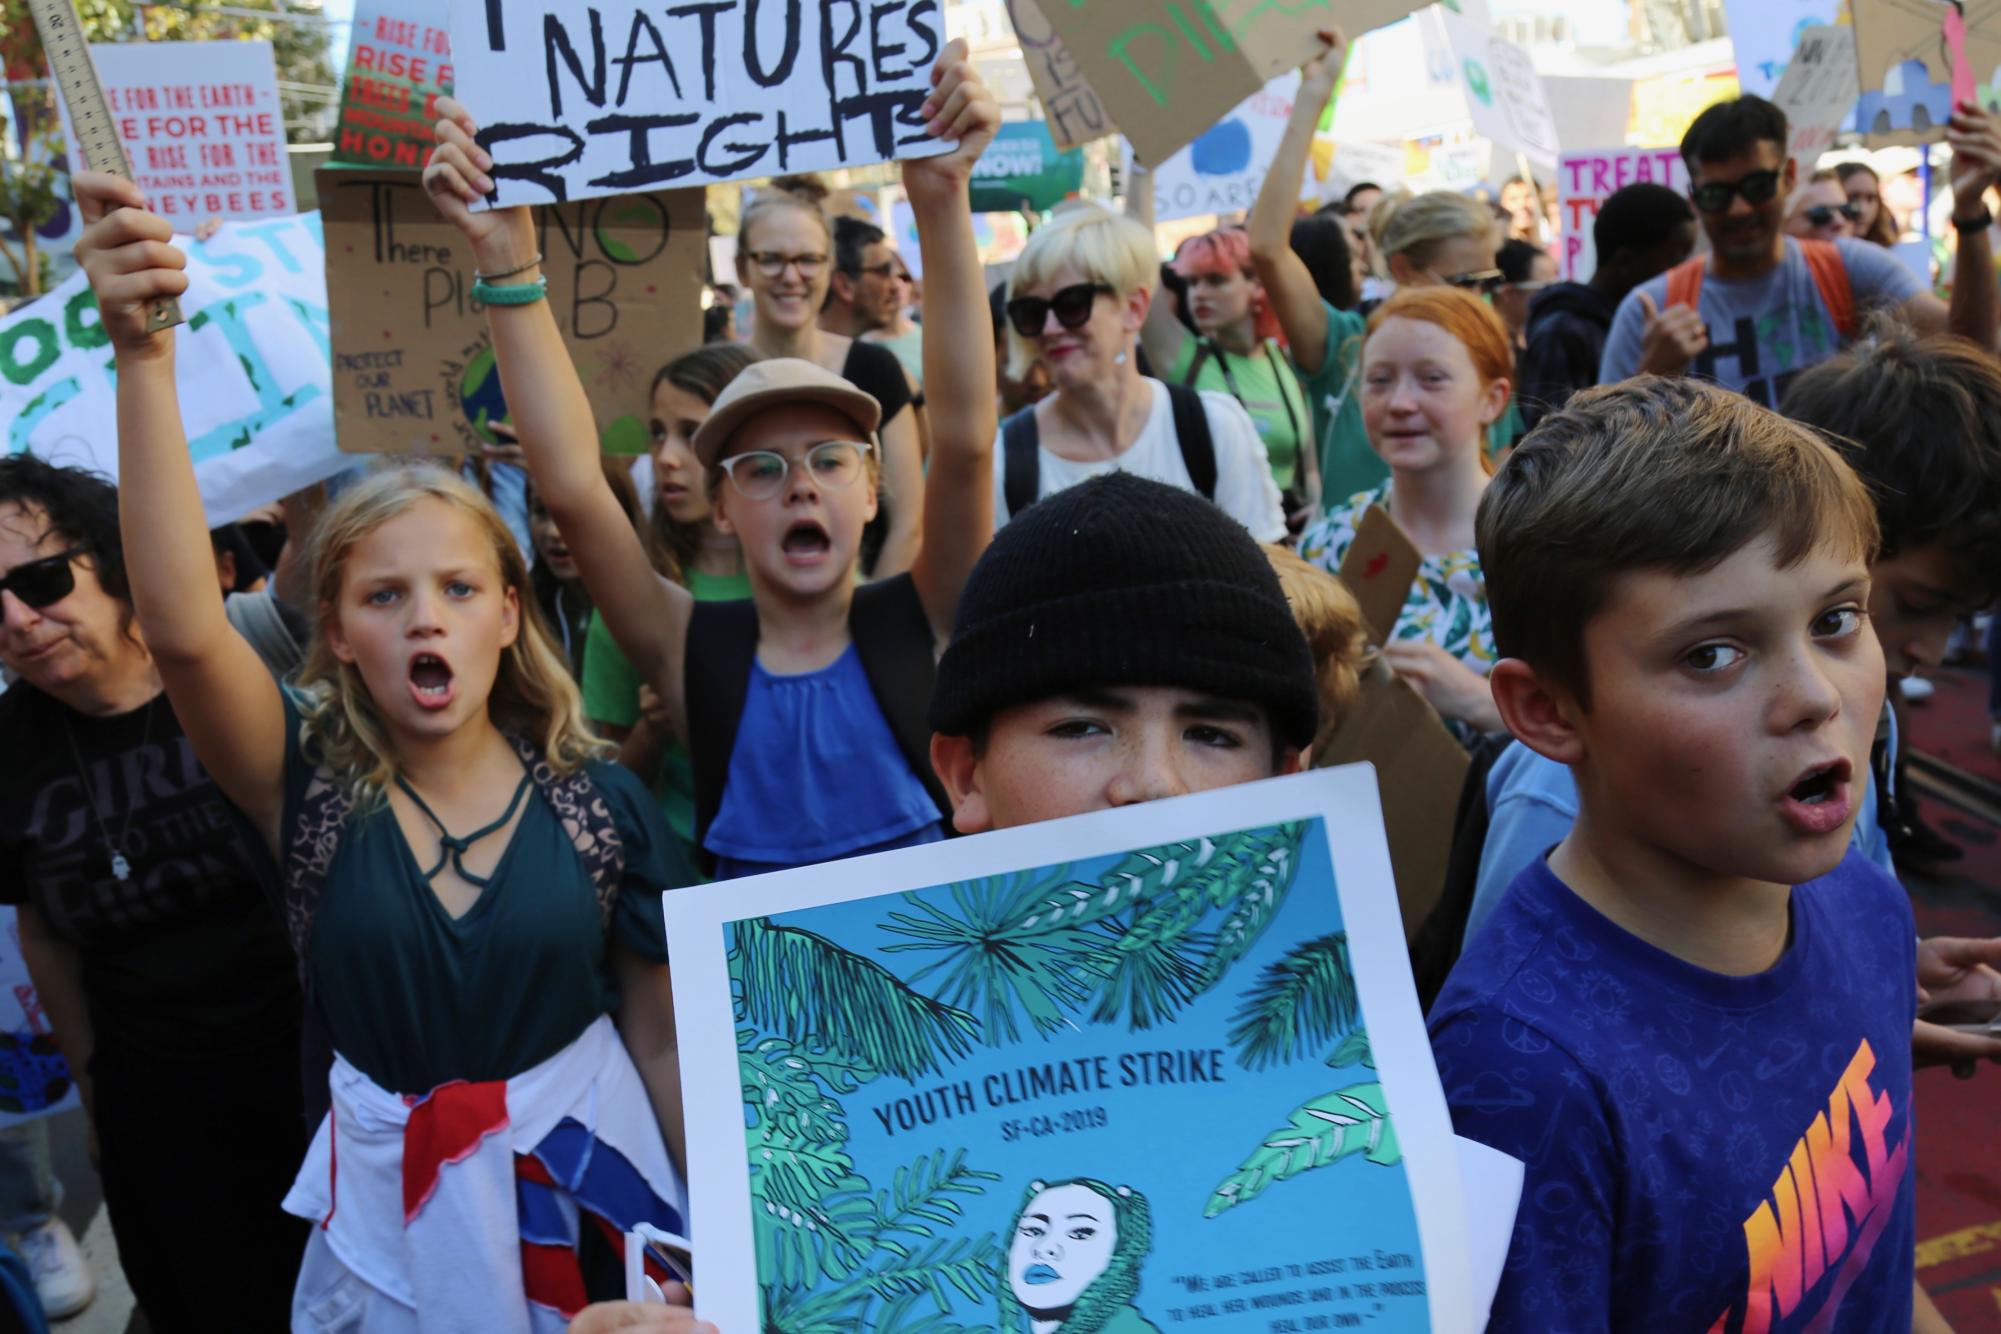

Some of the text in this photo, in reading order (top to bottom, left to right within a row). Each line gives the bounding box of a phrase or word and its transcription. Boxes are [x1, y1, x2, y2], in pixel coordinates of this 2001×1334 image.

[375, 15, 417, 49] RISE
[355, 44, 427, 84] RISE
[544, 0, 938, 121] NATURES
[124, 87, 158, 110] FOR
[163, 86, 195, 109] THE
[201, 84, 255, 108] EARTH
[147, 115, 206, 138] FOR
[215, 113, 274, 136] THE
[147, 143, 189, 170] RISE
[200, 143, 236, 168] FOR
[246, 141, 280, 166] THE
[474, 88, 934, 208] RIGHTS
[973, 152, 1043, 178] NOW!
[200, 173, 242, 187] AND
[245, 171, 283, 185] THE
[337, 179, 671, 266] There NO
[572, 259, 618, 340] B
[365, 389, 434, 420] PLANET
[872, 1048, 1226, 1137] YOUTH CLIMATE STRIKE
[1742, 1037, 1893, 1334] NIKE
